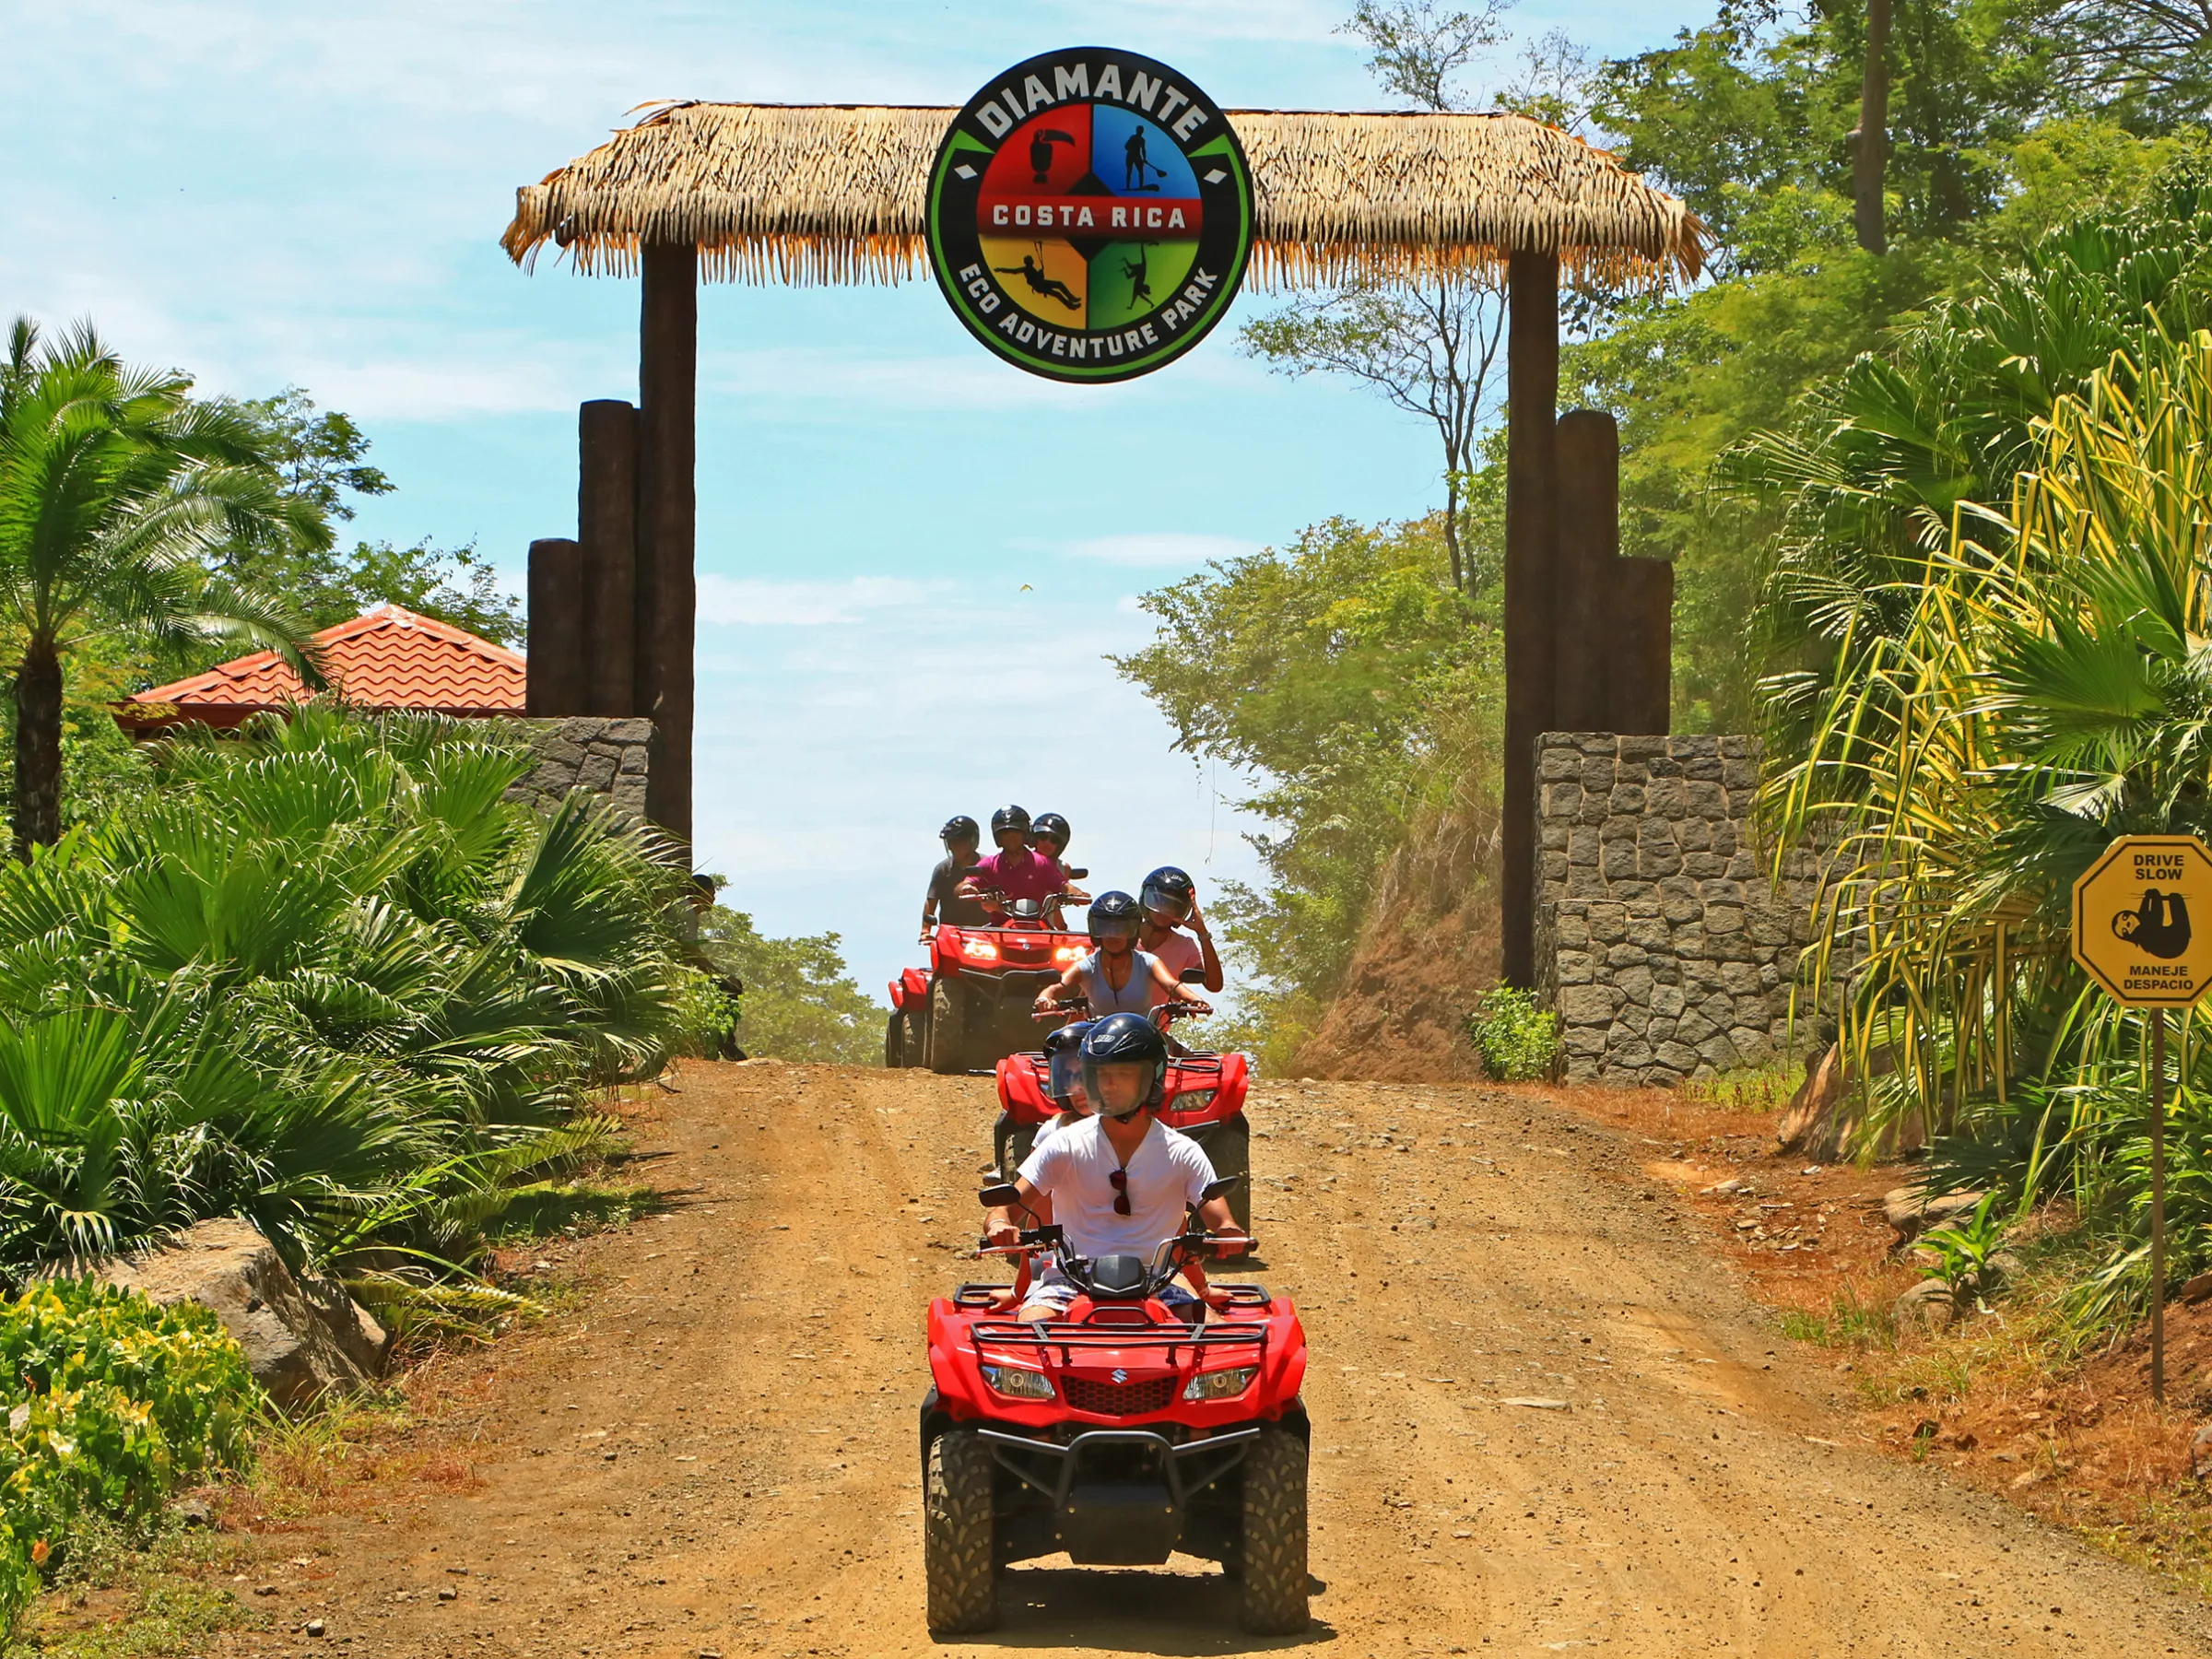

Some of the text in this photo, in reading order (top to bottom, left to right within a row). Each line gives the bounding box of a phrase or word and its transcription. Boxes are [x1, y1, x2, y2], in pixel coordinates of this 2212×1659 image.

[975, 64, 1208, 141] DIAMANTE
[993, 205, 1185, 229] COSTA RICA
[959, 264, 1218, 359] ECO ADVENTURE PARK
[2134, 854, 2184, 866] DRIVE
[2135, 868, 2183, 880] SLOW
[2129, 966, 2188, 976] MANEJE
[2124, 979, 2194, 990] DESPACIO
